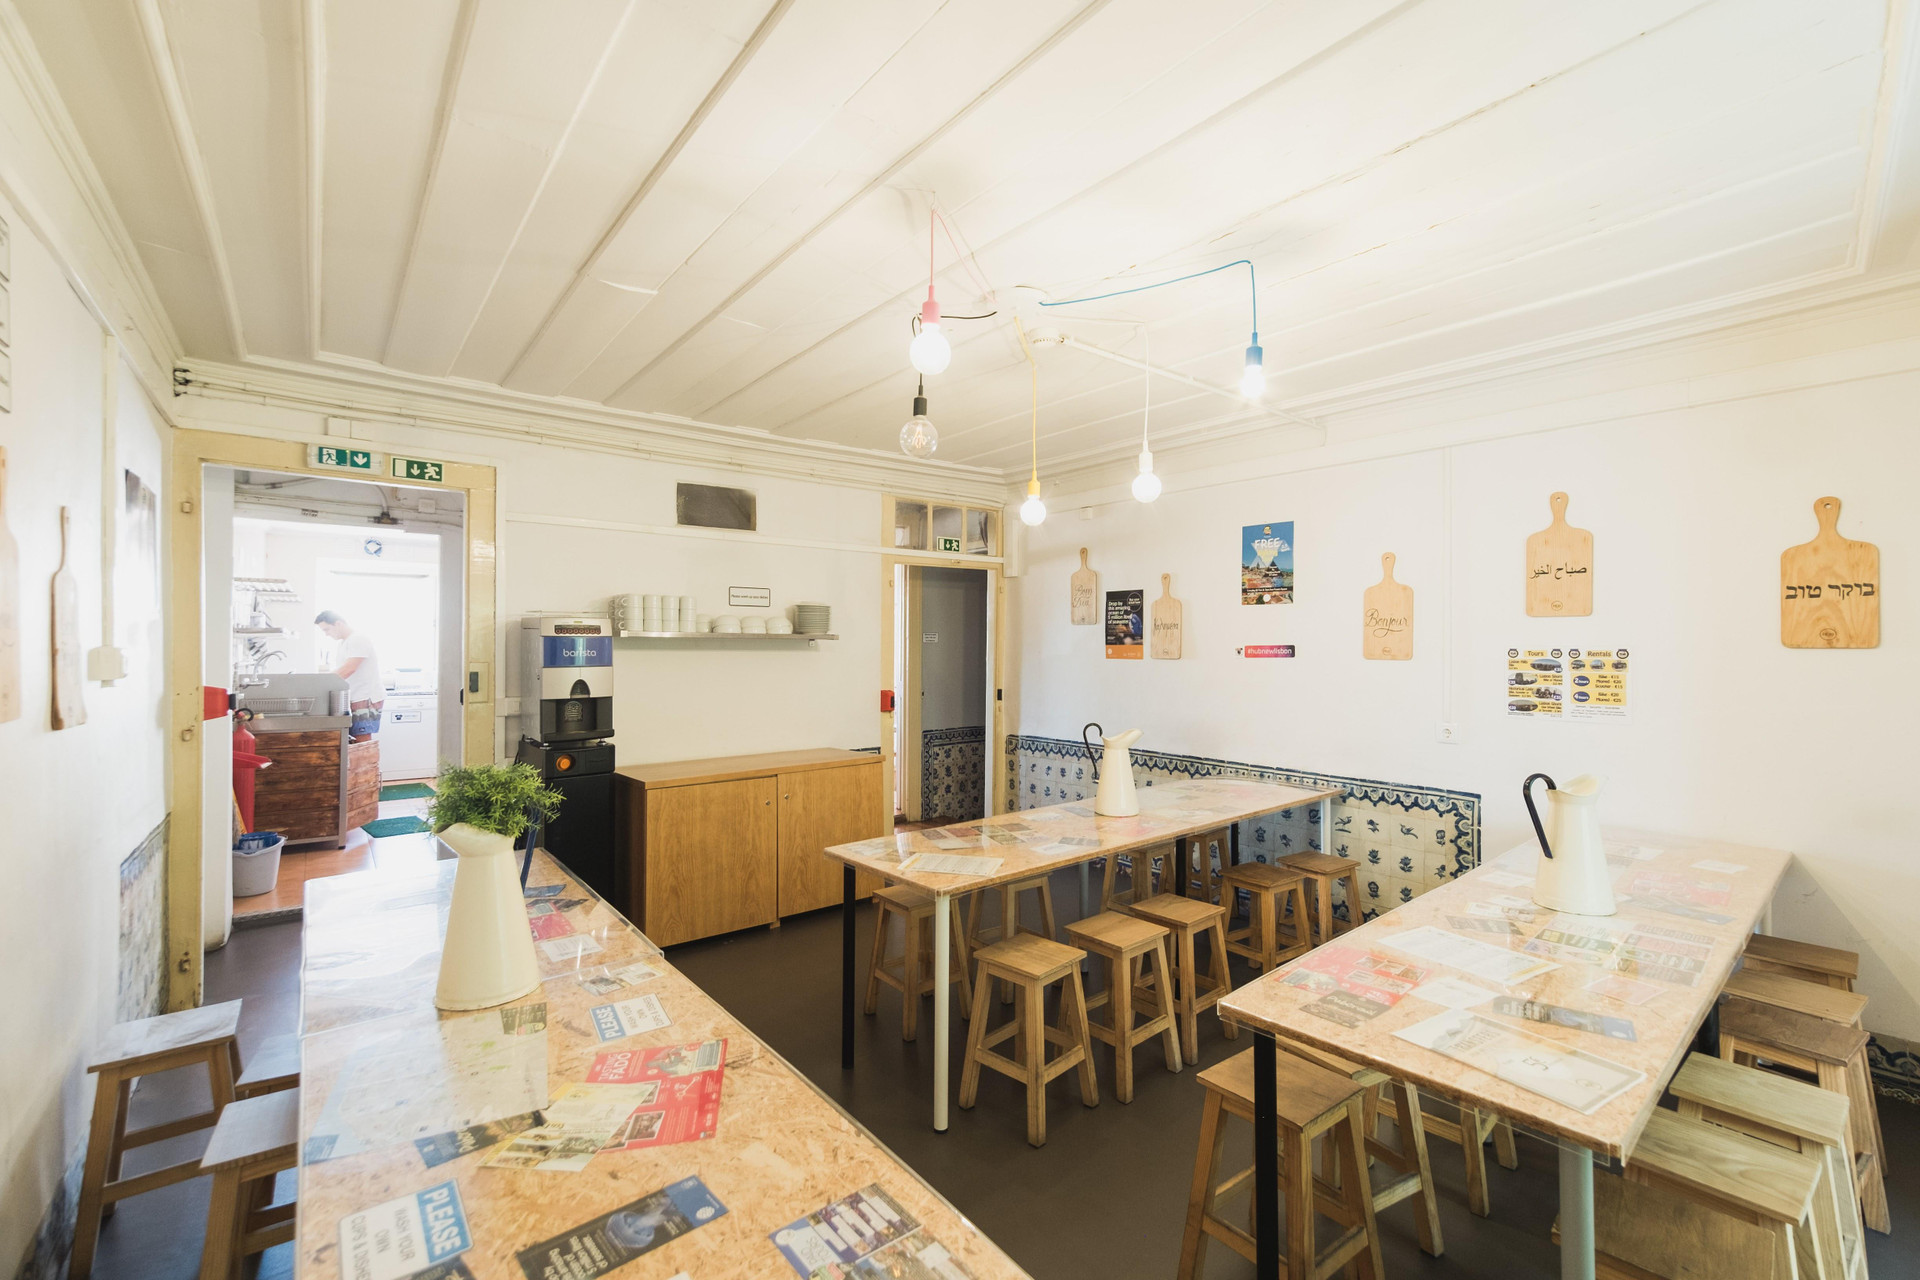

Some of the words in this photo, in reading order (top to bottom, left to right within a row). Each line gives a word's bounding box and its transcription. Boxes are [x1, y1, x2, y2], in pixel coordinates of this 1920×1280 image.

[1254, 537, 1280, 549] FREE
[1529, 564, 1551, 579] الخير
[1554, 562, 1587, 580] صباح
[1785, 585, 1822, 599] טוב
[1828, 582, 1875, 600] בוקר
[1365, 608, 1408, 638] Bonjour
[563, 647, 597, 657] barista
[1247, 647, 1292, 655] #hubnewlisbon
[596, 1006, 622, 1039] PLEASE
[609, 1053, 631, 1079] FADO
[351, 1215, 368, 1241] CUPS
[394, 1207, 411, 1235] WASH
[423, 1187, 462, 1256] PLEASE
[375, 1229, 391, 1254] OWN
[399, 1233, 416, 1262] YOUR
[354, 1250, 372, 1280] DISHE
